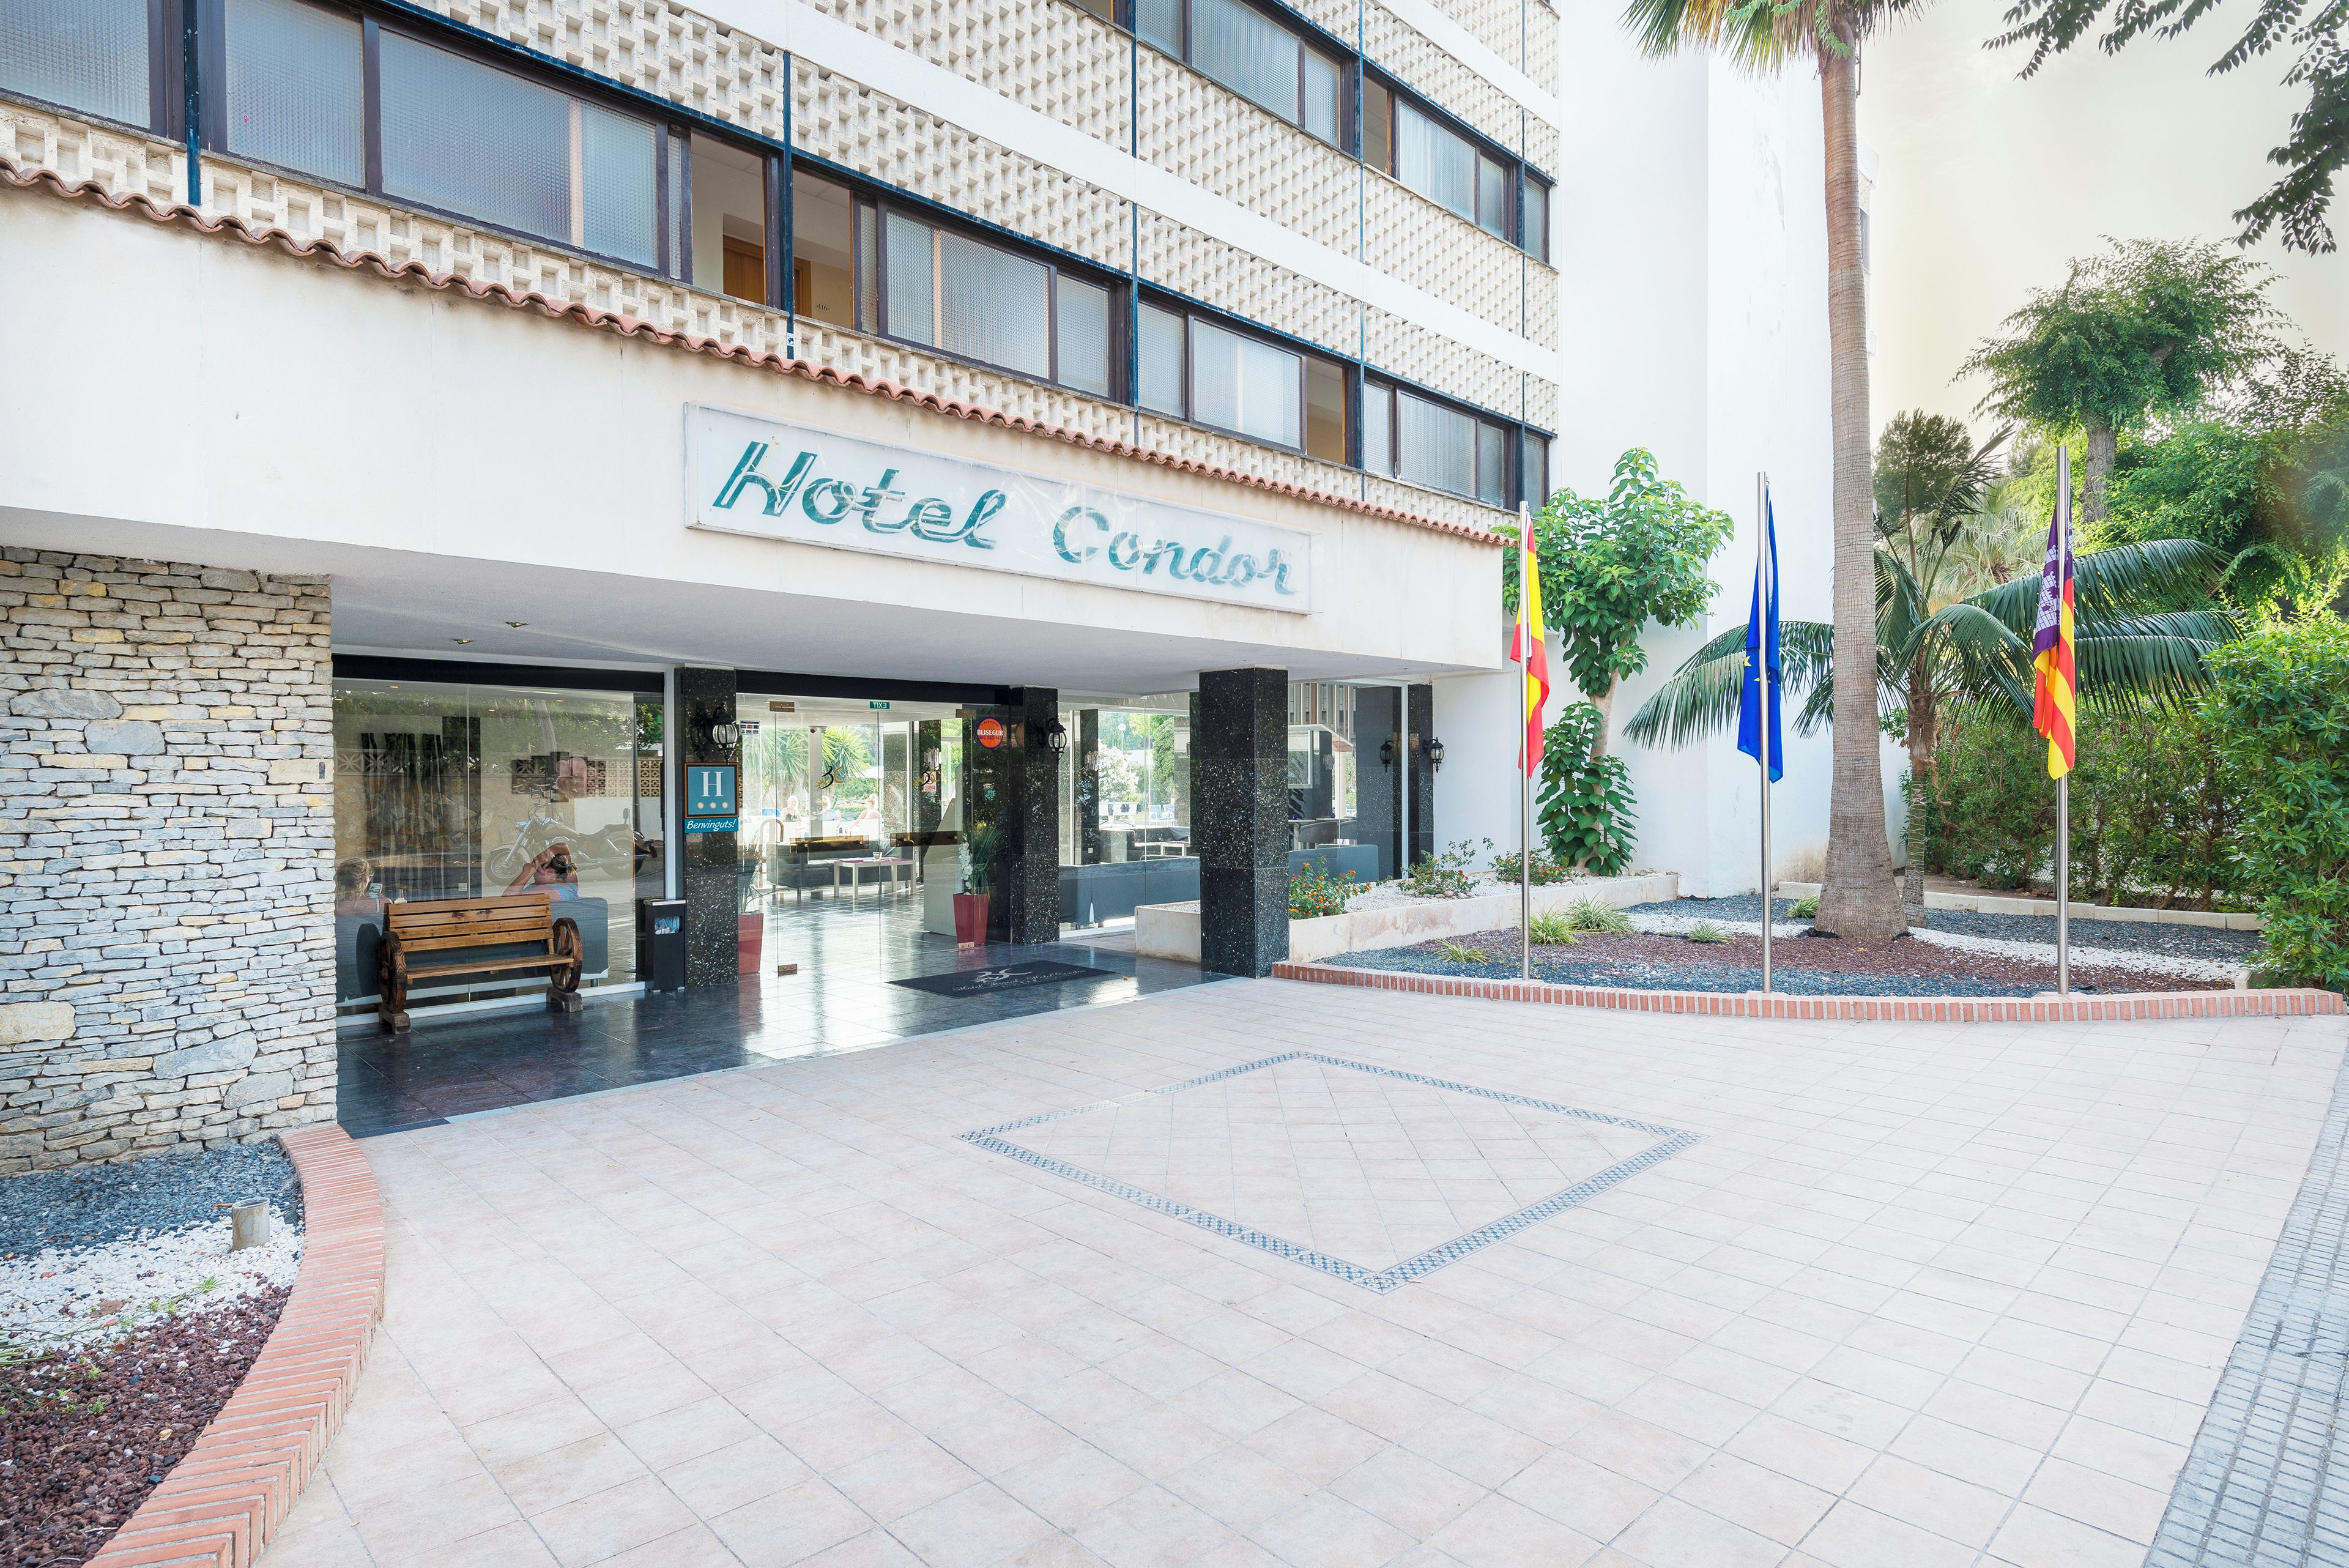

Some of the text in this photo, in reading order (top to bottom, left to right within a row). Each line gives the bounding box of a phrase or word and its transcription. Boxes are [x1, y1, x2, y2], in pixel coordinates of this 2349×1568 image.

[712, 440, 1295, 595] Hotel Condor
[700, 771, 724, 797] H
[686, 819, 735, 831] Benvinguts!
